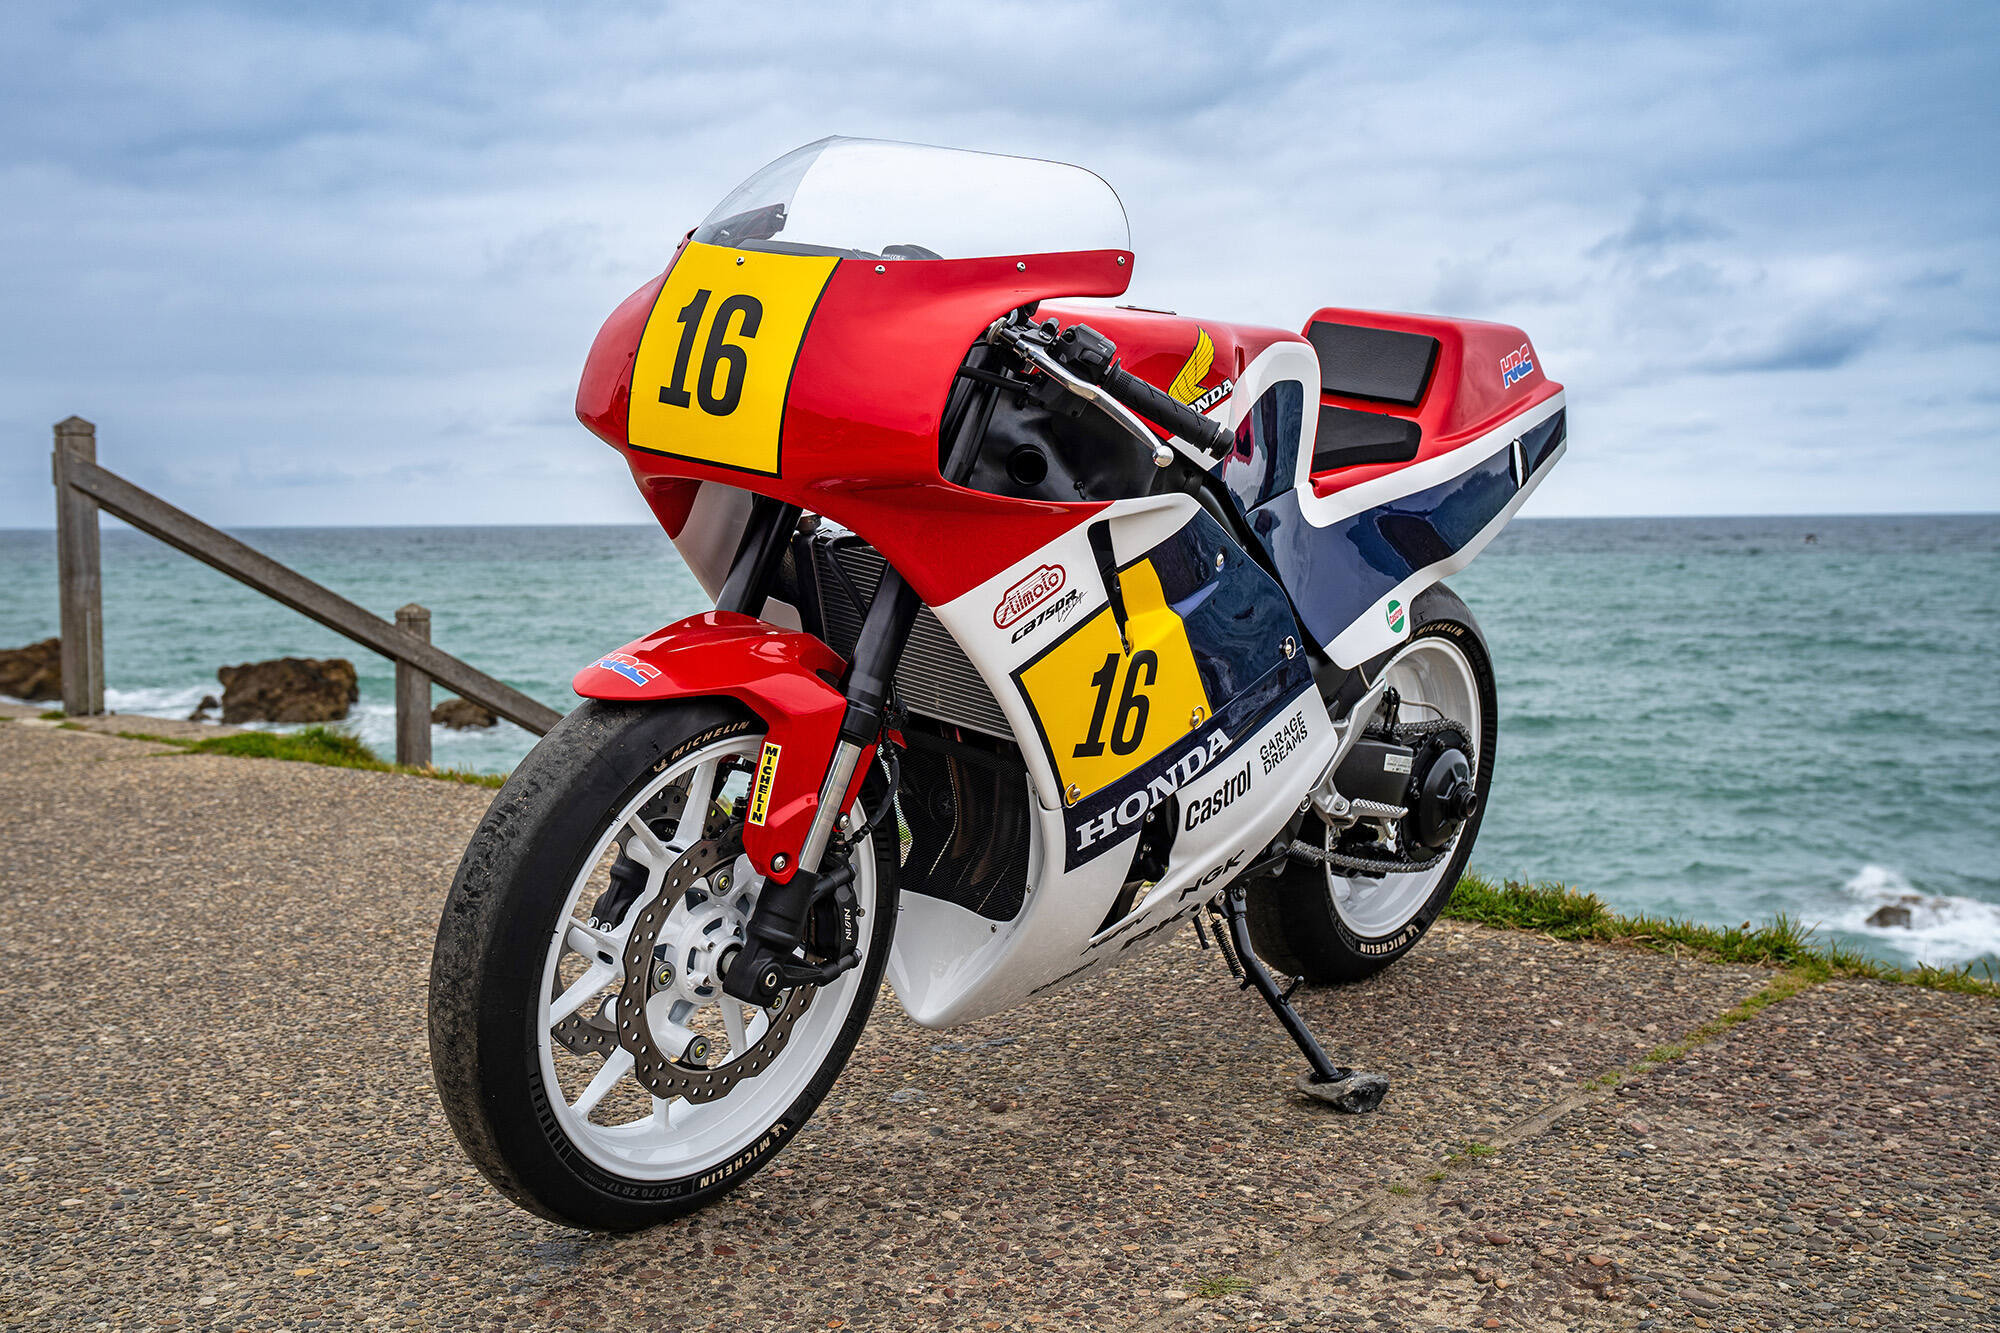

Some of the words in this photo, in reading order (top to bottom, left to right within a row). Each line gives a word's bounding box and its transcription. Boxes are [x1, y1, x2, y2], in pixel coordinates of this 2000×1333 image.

[658, 288, 763, 416] 16
[1500, 343, 1534, 389] HRC
[1188, 378, 1234, 413] NDA
[1010, 588, 1078, 644] CB750R
[1415, 622, 1465, 638] MICHELIN
[1072, 649, 1158, 758] 16
[670, 720, 751, 760] MICHELIN
[1259, 711, 1304, 761] GARAGE
[1262, 725, 1308, 776] DREAMS
[751, 745, 779, 823] MICHELIN
[1075, 727, 1234, 851] HONDA
[1184, 760, 1252, 832] Castrol
[1177, 849, 1245, 903] NGK
[1360, 932, 1407, 955] MICHELIN
[700, 1136, 770, 1189] MICHELIN
[606, 1183, 620, 1193] 17
[622, 1186, 638, 1197] ZR
[641, 1185, 682, 1198] 120/70
